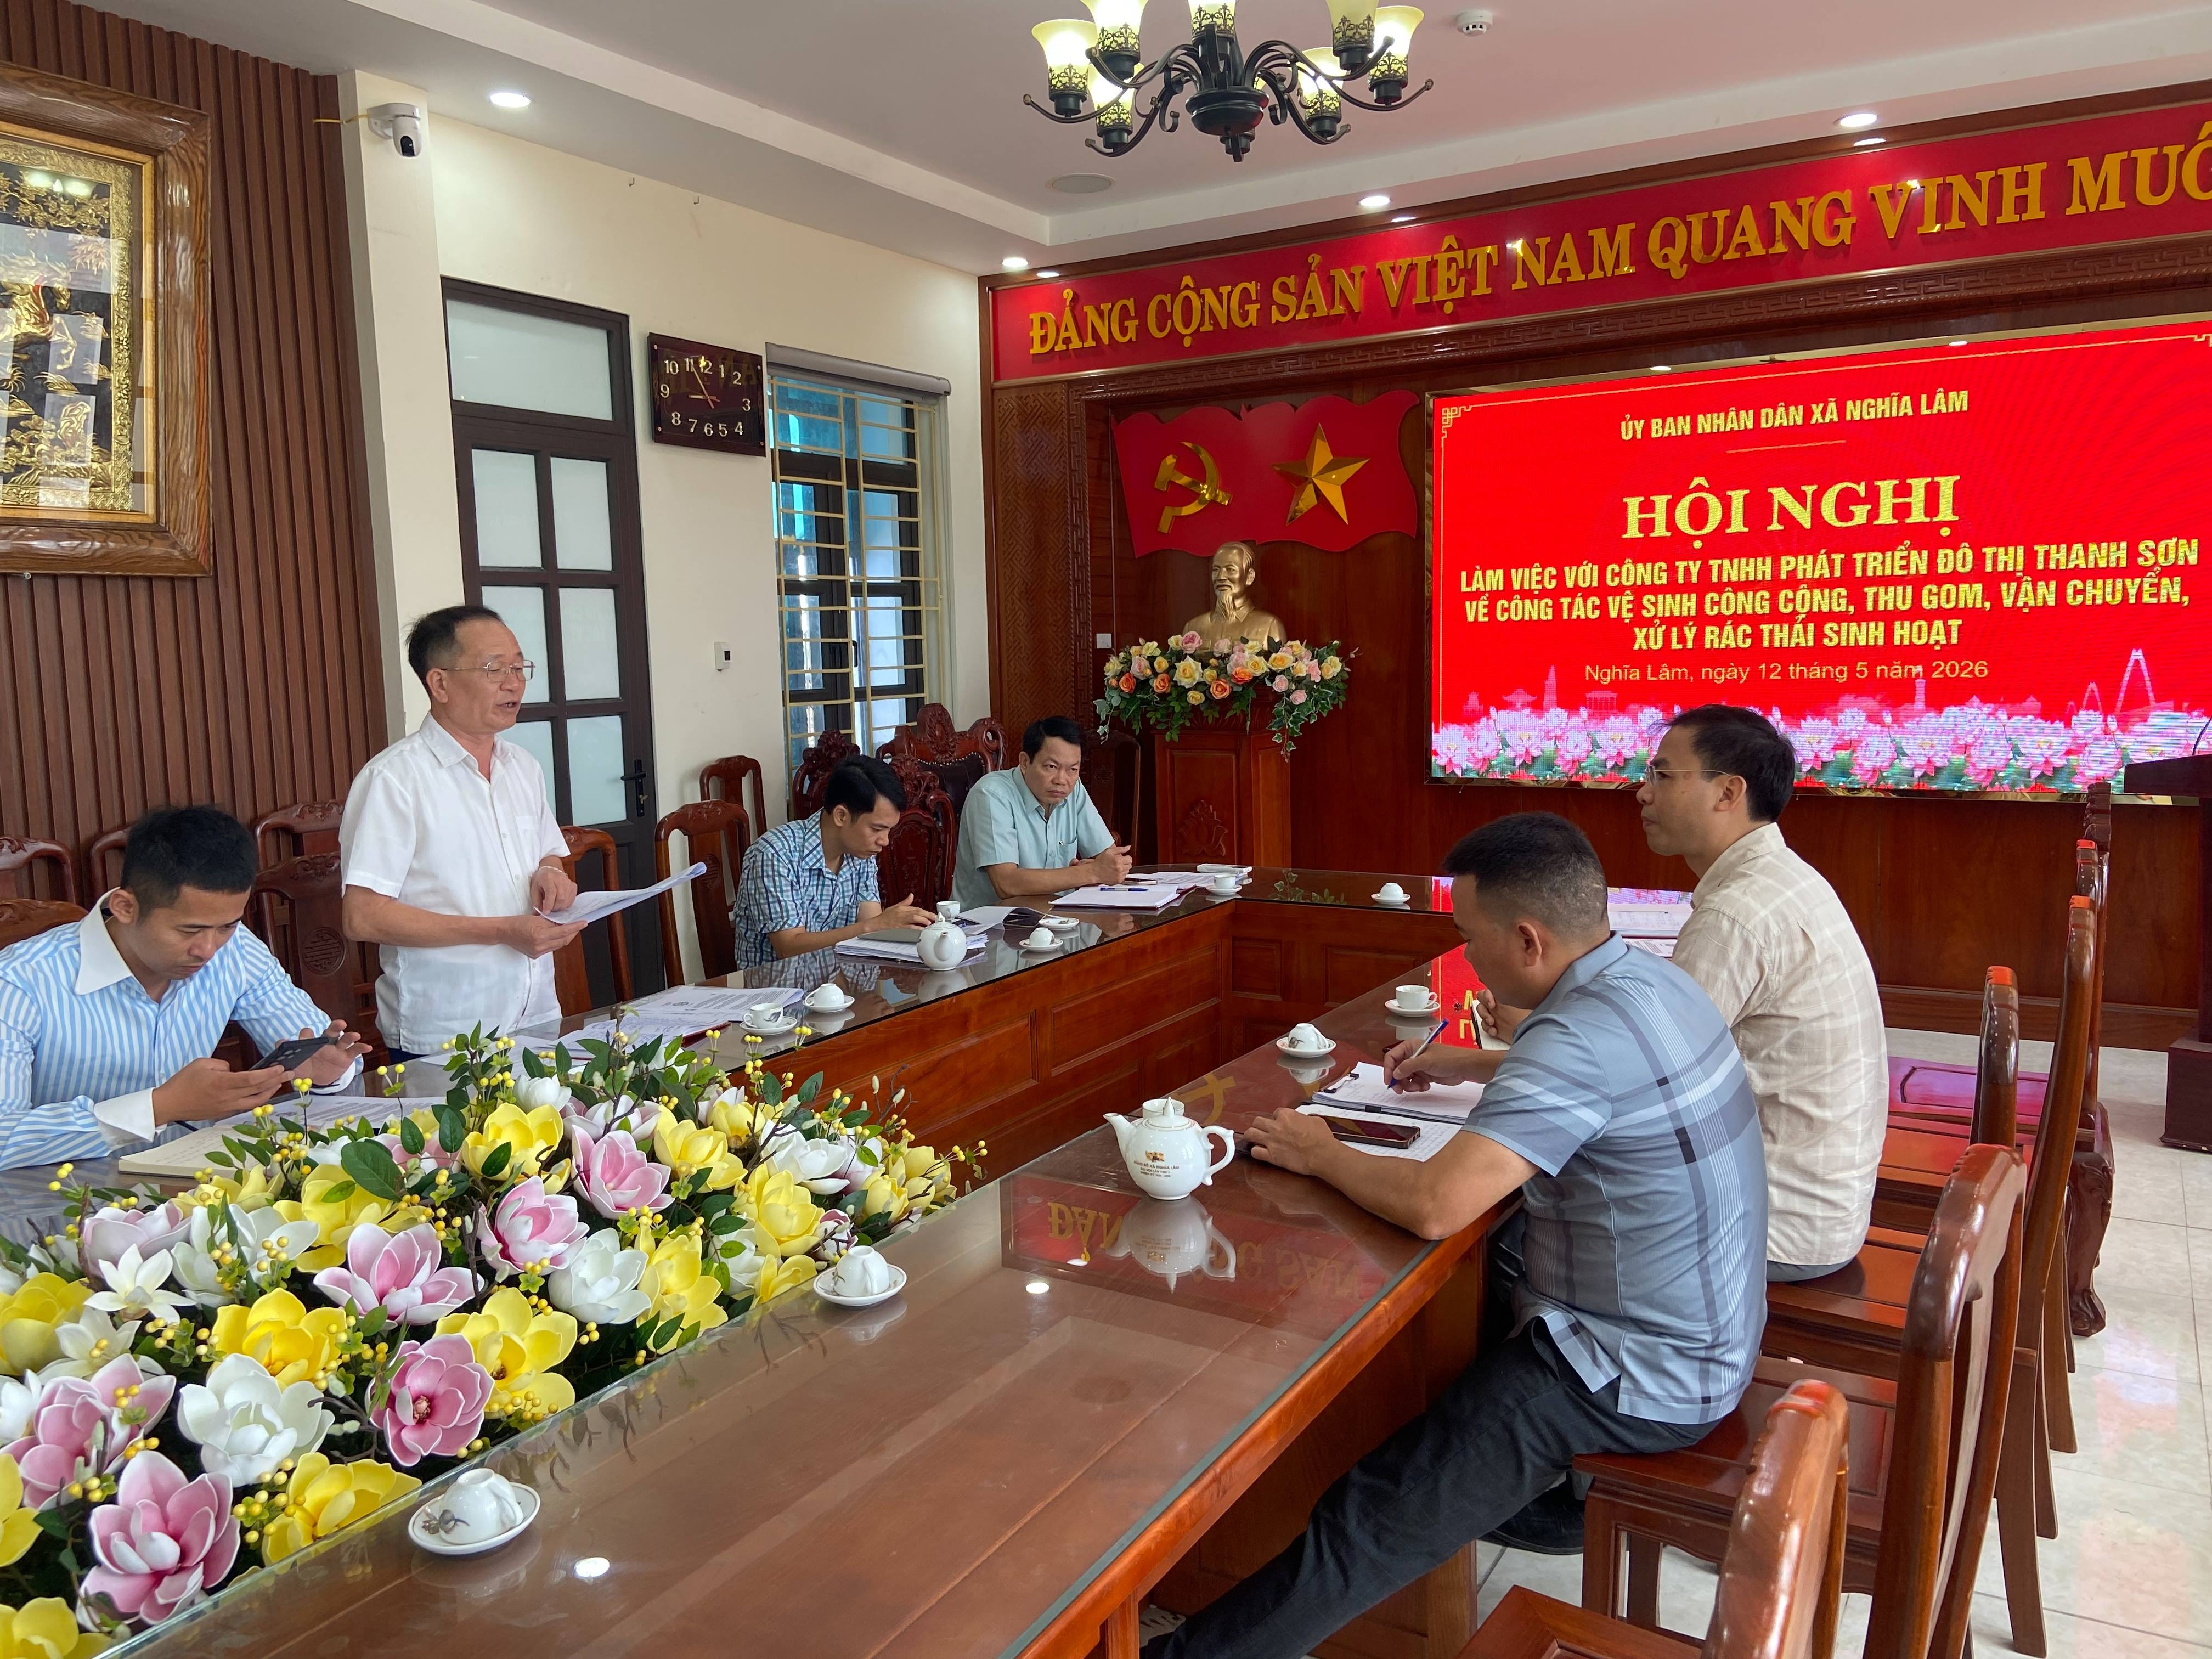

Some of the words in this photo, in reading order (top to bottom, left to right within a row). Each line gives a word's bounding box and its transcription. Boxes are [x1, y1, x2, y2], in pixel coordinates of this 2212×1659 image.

[1029, 289, 1138, 354] ĐẢNG
[1148, 276, 1260, 347] CỘNG
[1272, 254, 1364, 324] SẢN
[1376, 235, 1498, 314] VIỆT
[1511, 223, 1636, 290] NAM
[1648, 190, 1857, 279] QUANG
[1869, 162, 2047, 239] VINH
[664, 359, 679, 375] 10
[719, 364, 724, 378] 1
[732, 371, 742, 385] 2
[660, 383, 670, 398] 9
[742, 398, 751, 411] 3
[672, 411, 681, 426] 8
[1621, 414, 1645, 441] ỦY
[1651, 415, 1691, 438] BAN
[1697, 407, 1754, 434] NHÂN
[1760, 402, 1804, 428] DÂN
[1810, 398, 1839, 424] XÃ
[1846, 392, 1914, 421] NGHĨA
[1920, 388, 1969, 415] LÂM
[689, 419, 698, 433] 7
[704, 422, 713, 436] 6
[719, 423, 728, 437] 5
[735, 422, 744, 436] 4
[1622, 476, 1750, 549] HỘI
[1767, 475, 1961, 537] NGHỊ
[1461, 565, 1504, 592] LÀM
[1510, 562, 1558, 594] VIỆC
[1564, 560, 1599, 588] VỚI
[1606, 558, 1668, 587] CÔNG
[1675, 560, 1702, 584] TY
[1708, 551, 1772, 583] TNHH
[1780, 549, 1846, 580] PHÁT
[1852, 540, 1929, 577] TRIỂN
[1937, 542, 1974, 574] ĐÔ
[1982, 545, 2024, 577] THỊ
[2034, 541, 2128, 570] THANH
[2137, 536, 2199, 567] SƠN
[1465, 592, 1489, 622] VỀ
[1496, 594, 1553, 622] CÔNG
[1559, 592, 1601, 620] TÁC
[1607, 590, 1634, 623] VỆ
[1641, 593, 1697, 618] SINH
[1705, 587, 1770, 616] CÔNG
[1778, 583, 1855, 618] CỘNG,
[1863, 585, 1913, 612] THU
[1922, 583, 1991, 612] GOM,
[2000, 576, 2057, 613] VẬN
[2066, 566, 2190, 607] CHUYỂN,
[1633, 619, 1667, 650] XỬ
[1671, 621, 1698, 650] LÝ
[1705, 620, 1752, 649] RÁC
[1759, 615, 1814, 648] THẢI
[1822, 621, 1885, 647] SINH
[1893, 619, 1962, 650] HOẠT
[1585, 664, 1640, 685] Nghĩa
[1646, 663, 1694, 683] Lâm,
[1701, 663, 1750, 684] ngày
[1758, 663, 1782, 679] 12
[1788, 661, 1848, 683] tháng
[1855, 661, 1868, 679] 5
[1876, 660, 1923, 679] năm
[1931, 660, 1988, 678] 2026
